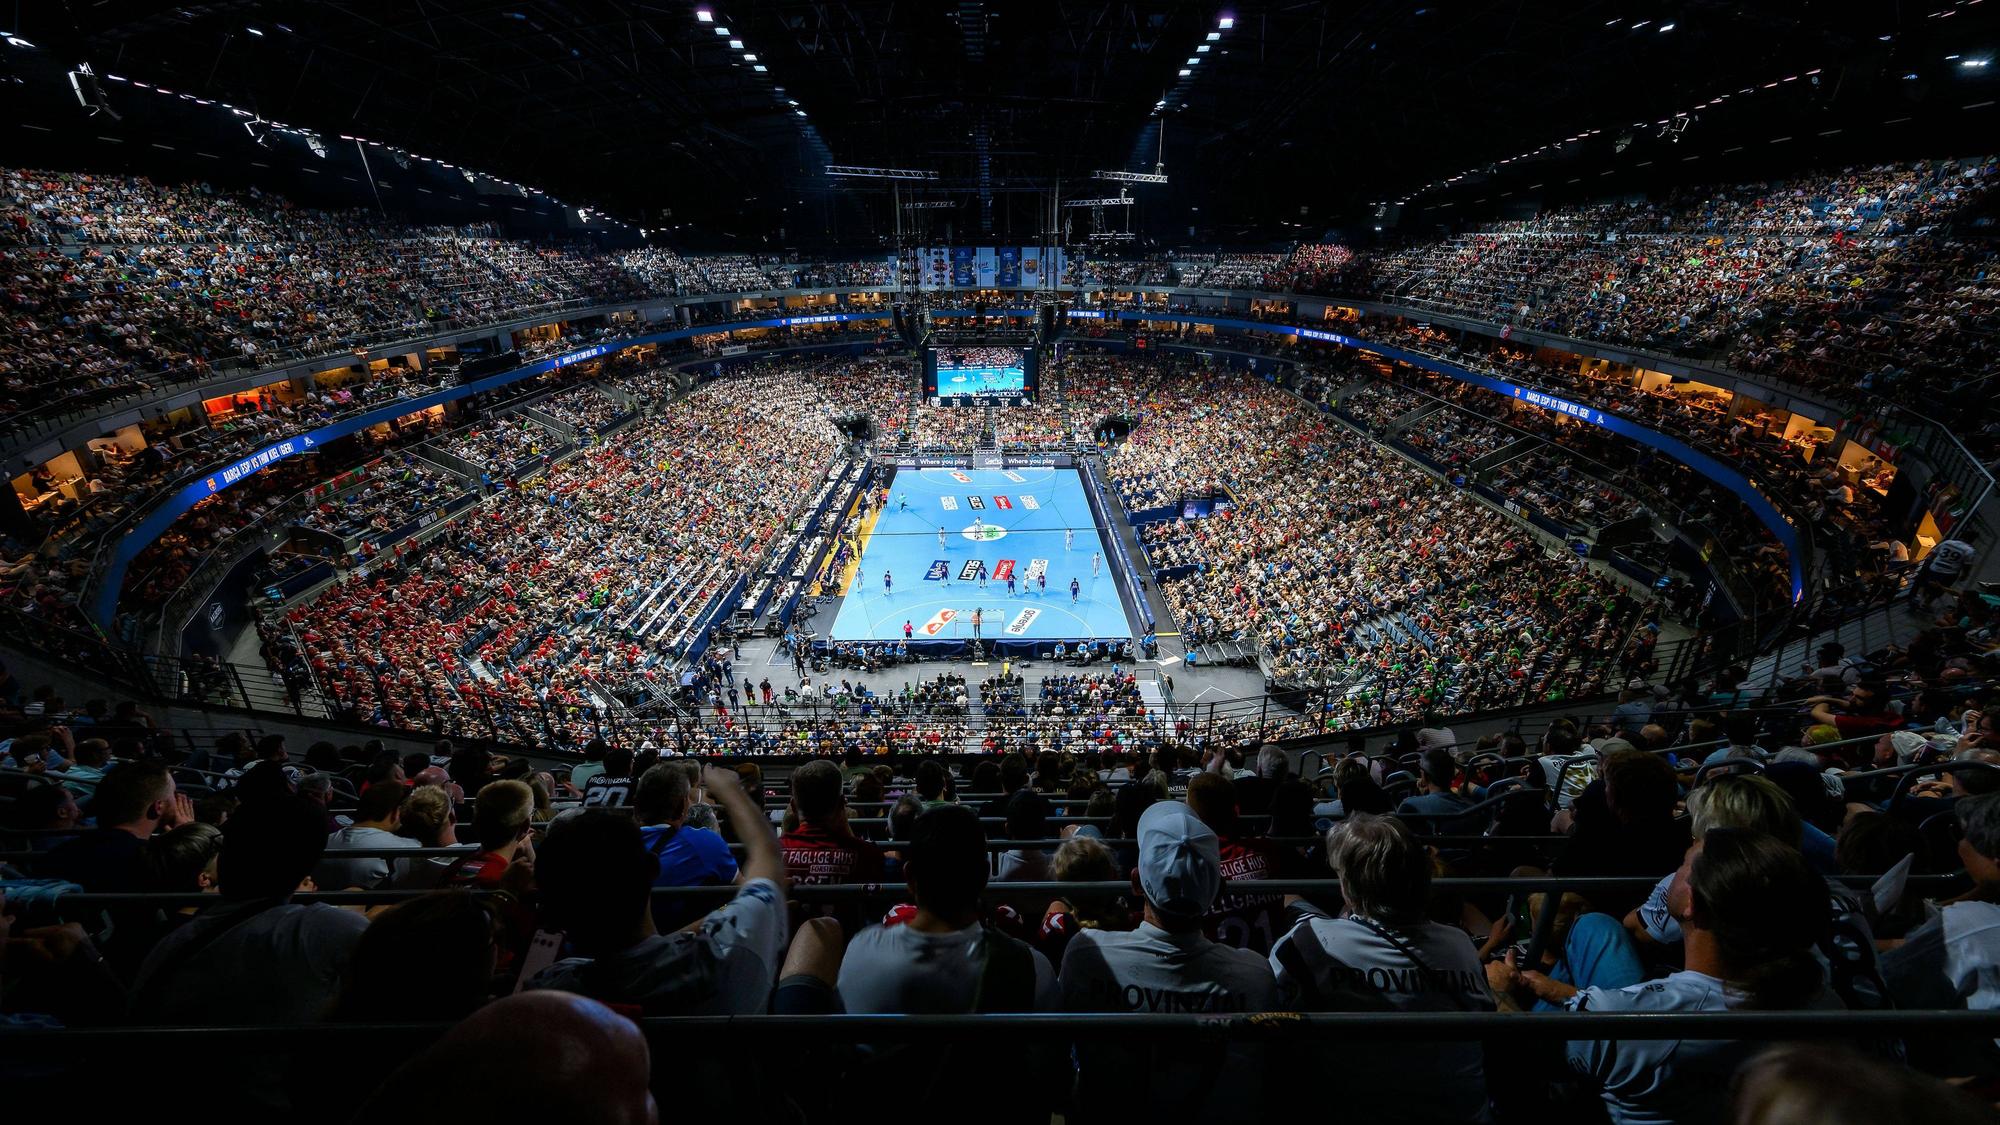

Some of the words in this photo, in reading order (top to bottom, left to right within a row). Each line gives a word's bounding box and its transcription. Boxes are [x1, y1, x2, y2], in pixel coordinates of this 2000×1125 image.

[1550, 399, 1557, 409] VS
[1557, 400, 1568, 412] THW
[1568, 404, 1578, 415] KIEL
[240, 461, 254, 475] (ESP)
[251, 457, 260, 470] VS
[257, 452, 270, 466] THW
[268, 447, 280, 461] KIEL
[278, 441, 295, 457] (GER)
[941, 459, 954, 467] you
[954, 458, 967, 467] play
[1029, 459, 1042, 467] you
[1041, 458, 1055, 467] play
[1010, 609, 1036, 633] gorenje
[788, 851, 831, 865] FAGLIGE
[1220, 859, 1248, 878] GLIGE
